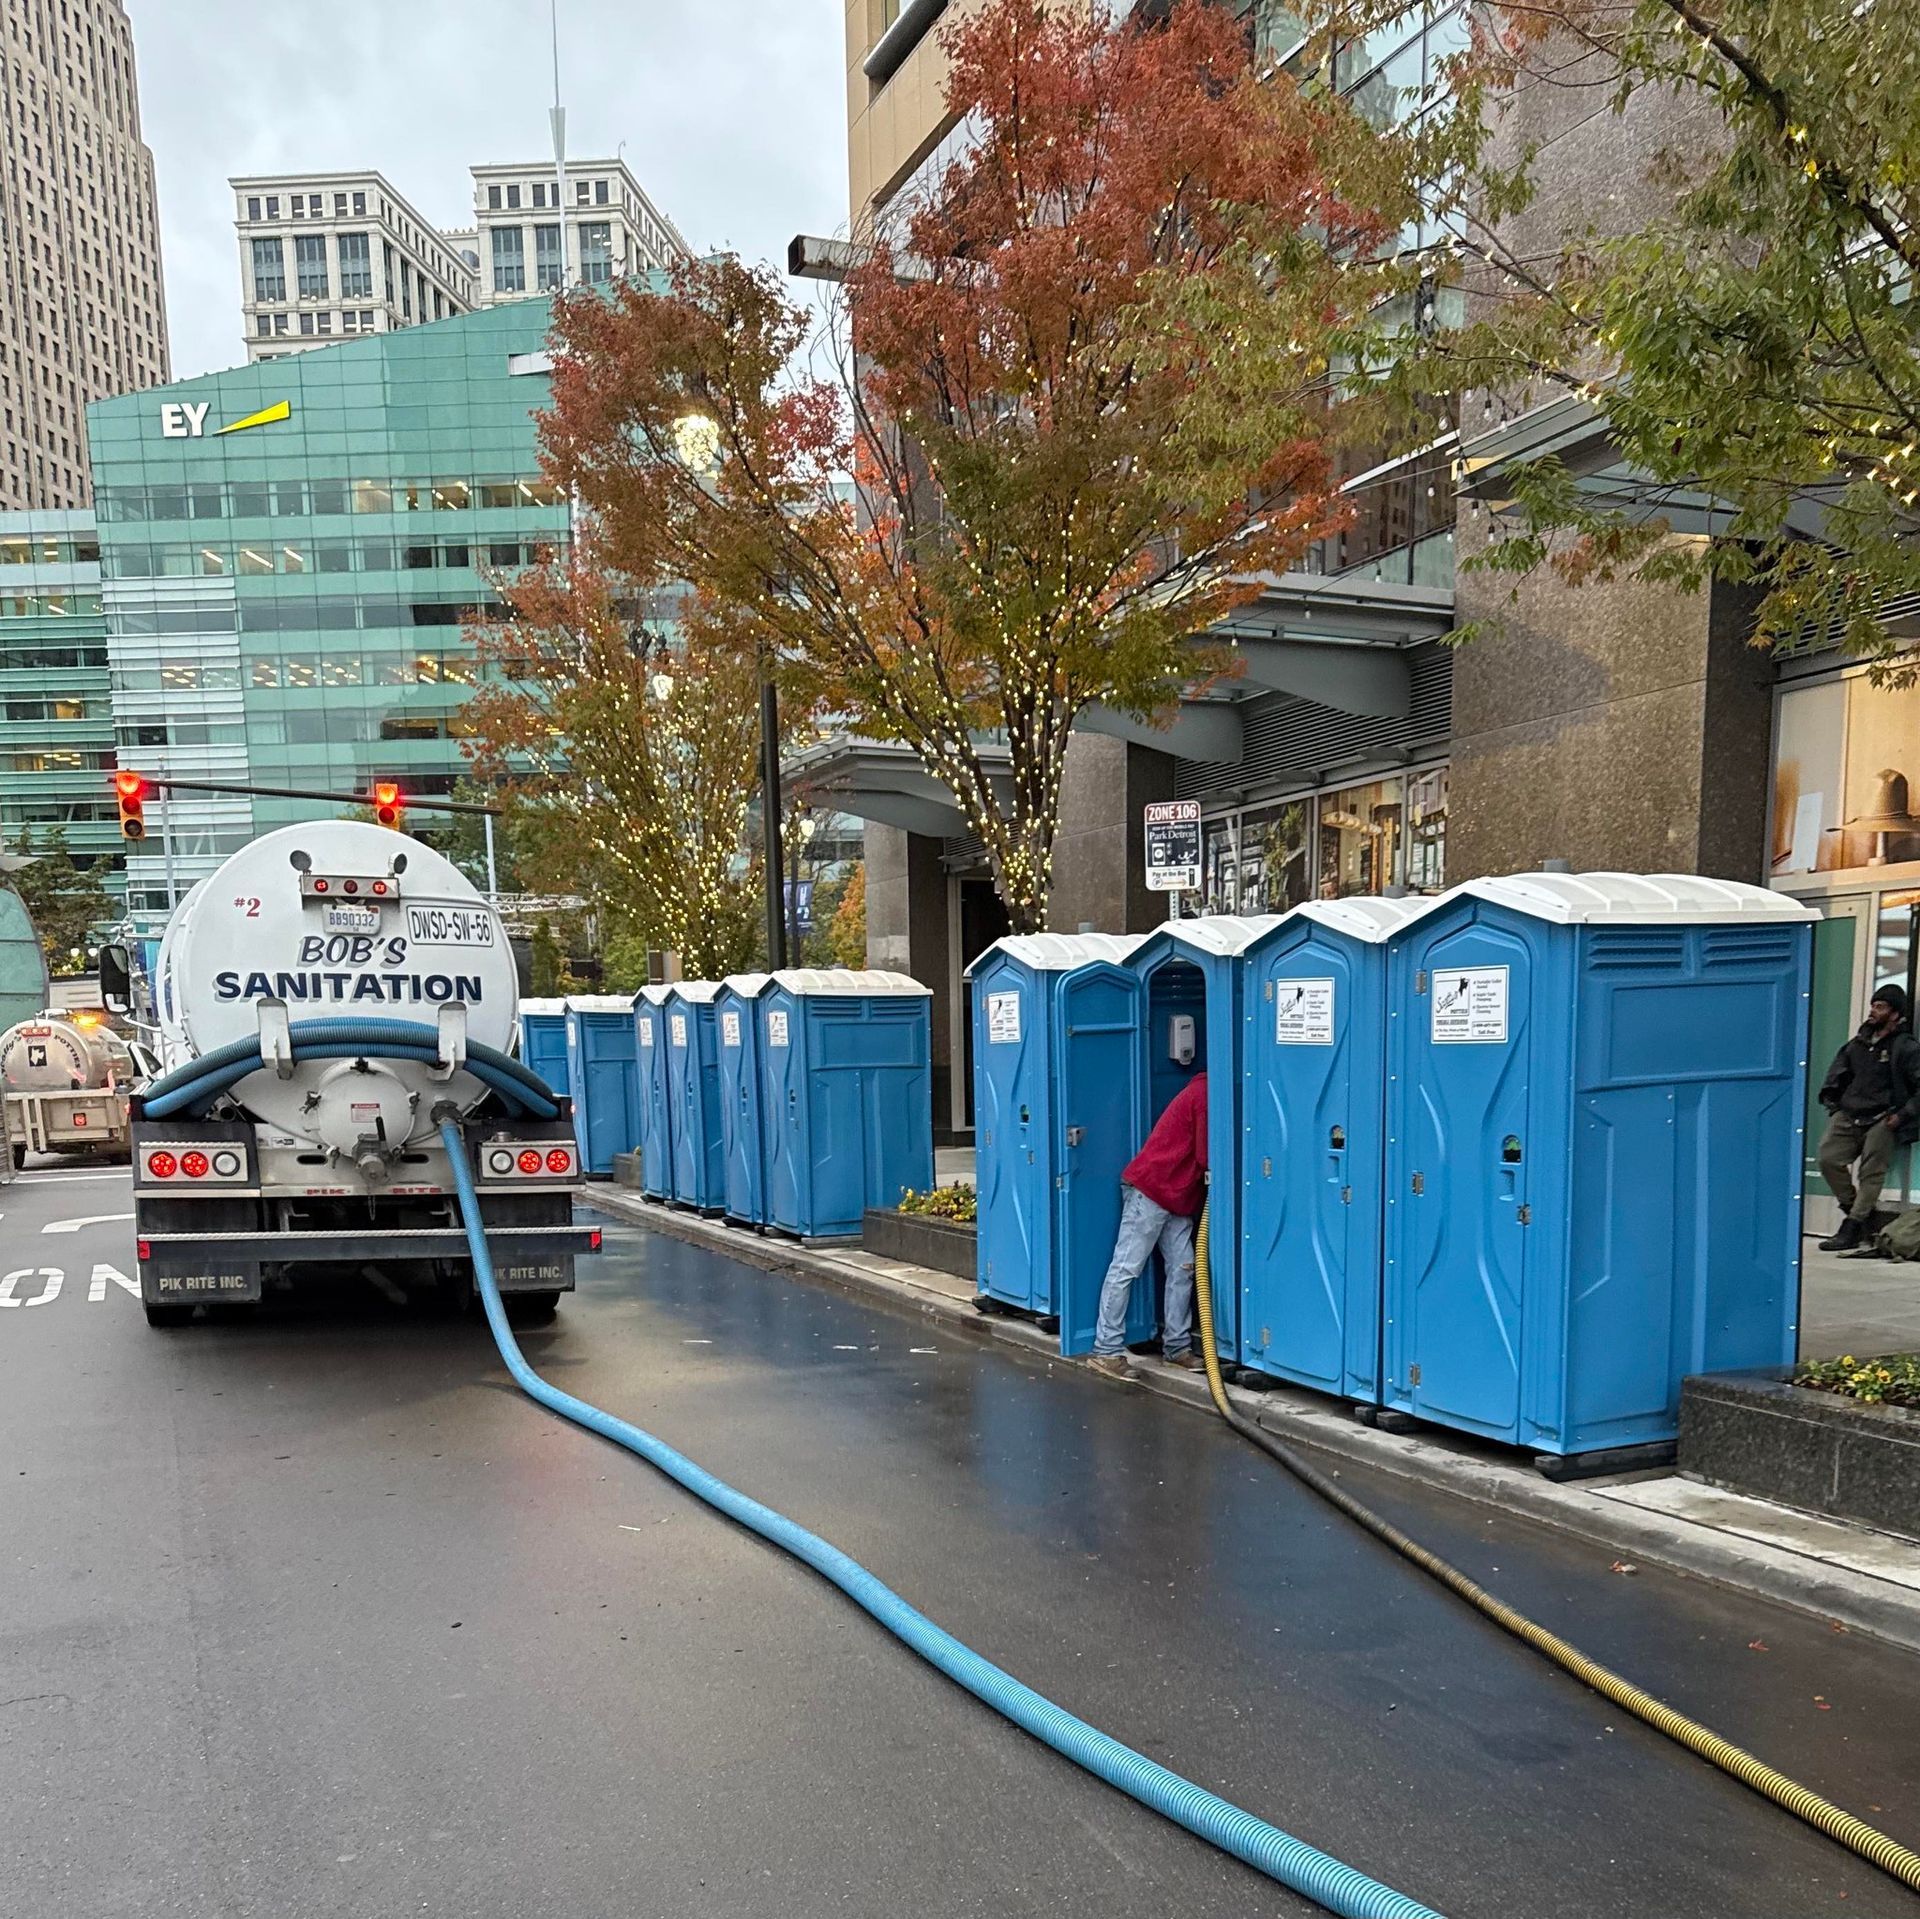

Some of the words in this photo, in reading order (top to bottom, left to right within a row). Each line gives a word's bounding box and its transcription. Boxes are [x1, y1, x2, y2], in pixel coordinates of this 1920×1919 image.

[161, 401, 210, 438] EY
[1148, 805, 1176, 821] ZONE
[1176, 804, 1197, 819] 106
[233, 897, 261, 917] #2
[329, 912, 375, 927] BB90332
[411, 910, 490, 941] DWSD-SW-56
[299, 935, 407, 966] BOB'S
[214, 971, 483, 1002] SANITATION
[54, 1034, 81, 1068] POTTIES
[160, 1277, 183, 1290] PIK
[186, 1276, 217, 1289] RITE
[220, 1275, 248, 1289] INC.
[494, 1267, 506, 1280] IK
[509, 1267, 536, 1280] RITE
[539, 1266, 564, 1279] INC.
